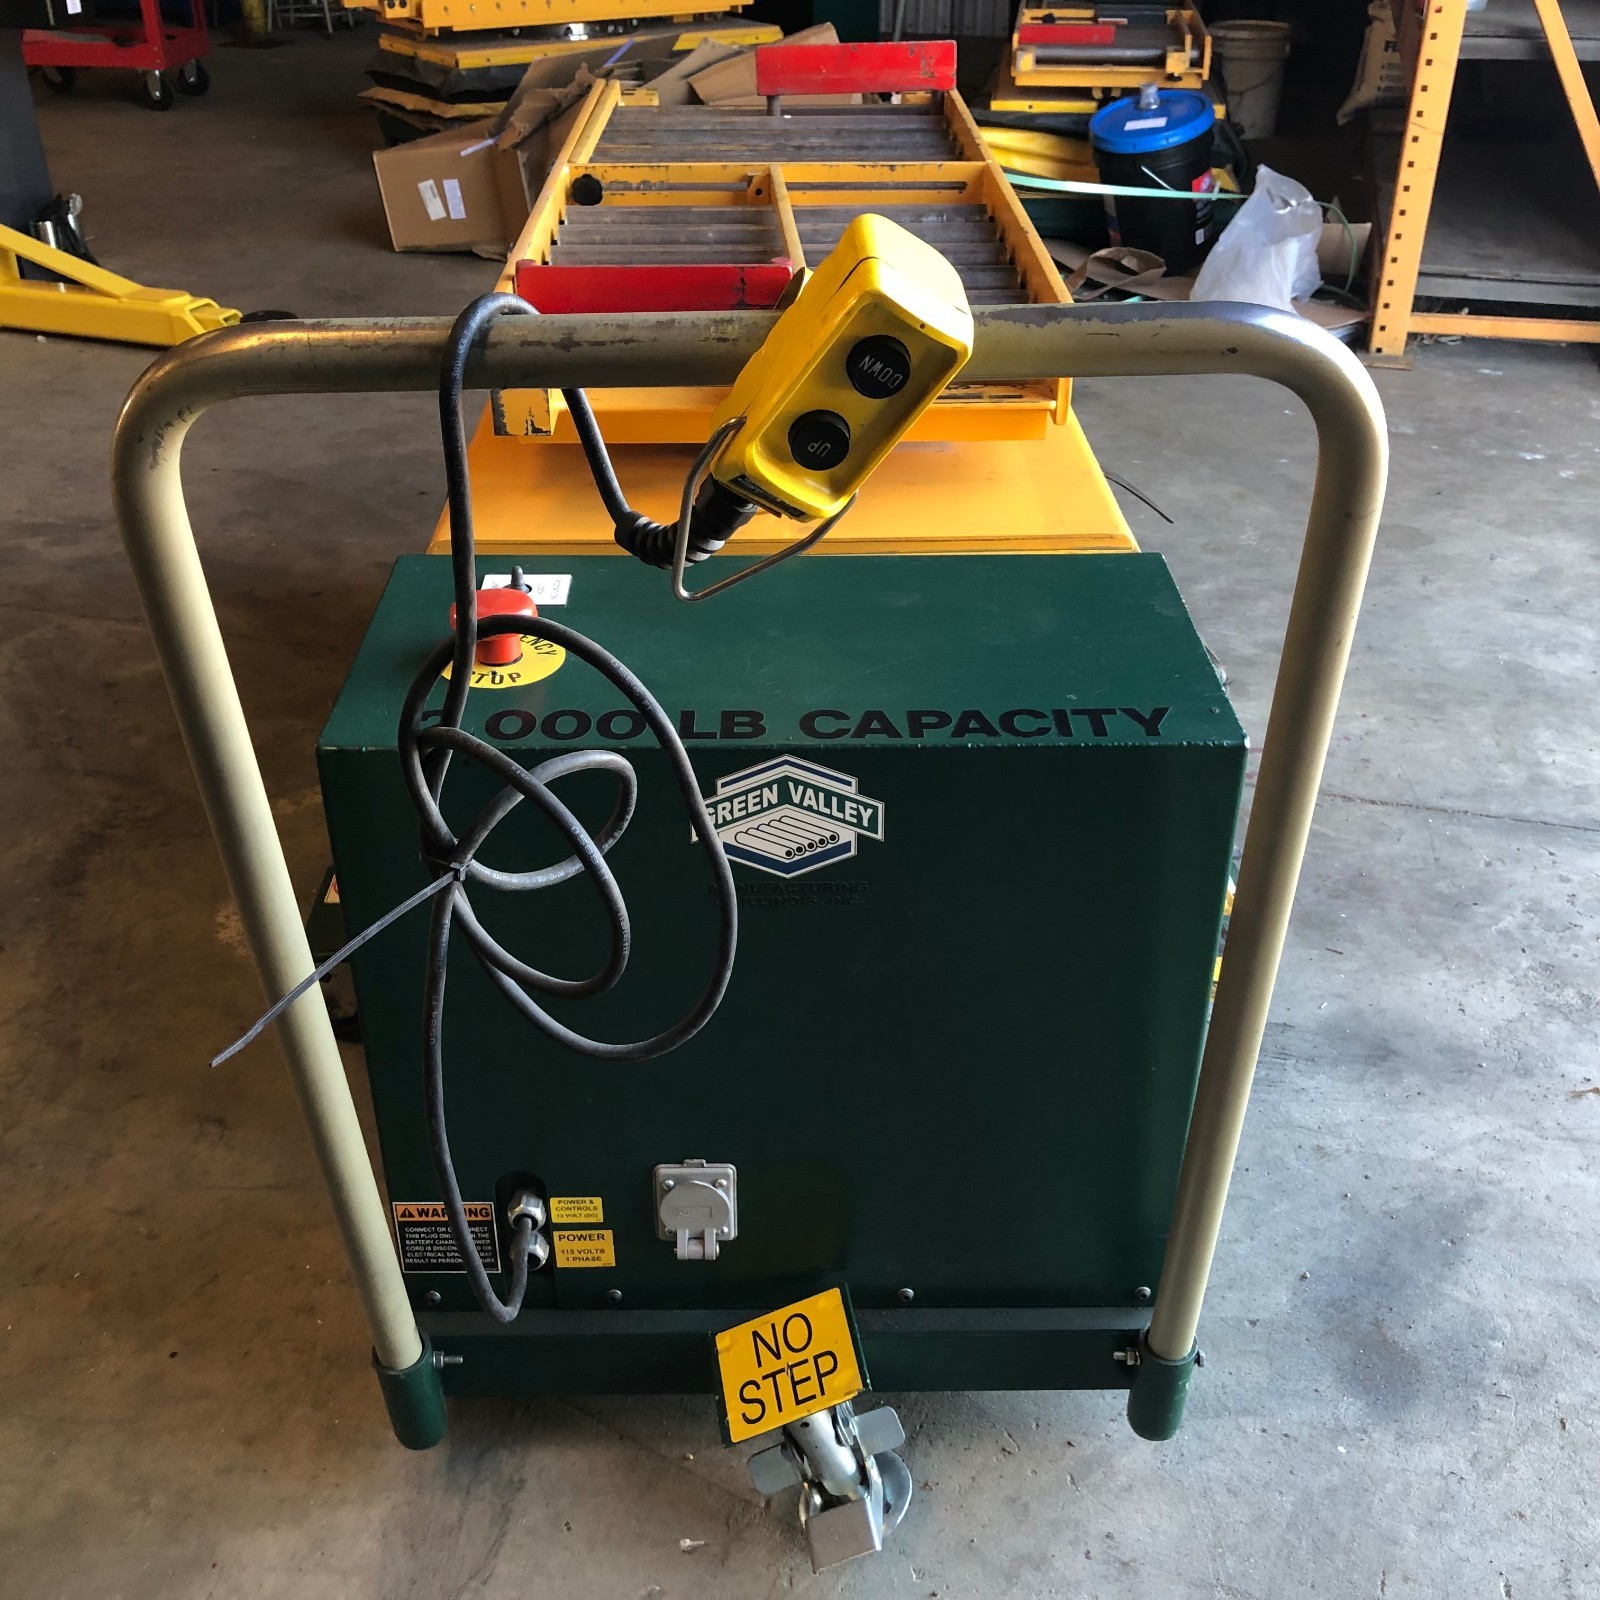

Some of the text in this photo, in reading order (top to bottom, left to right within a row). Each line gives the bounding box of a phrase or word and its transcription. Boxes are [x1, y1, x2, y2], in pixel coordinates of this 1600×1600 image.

[858, 354, 904, 389] DOWN
[807, 439, 832, 458] UP
[680, 710, 768, 740] LB
[799, 708, 1170, 739] CAPACITY
[788, 781, 874, 828] VALLEY
[707, 881, 869, 894] MNUFACTURING
[416, 1207, 490, 1219] WAING
[558, 1233, 605, 1242] POWER
[751, 1312, 813, 1368] NO
[738, 1350, 838, 1425] STEP
